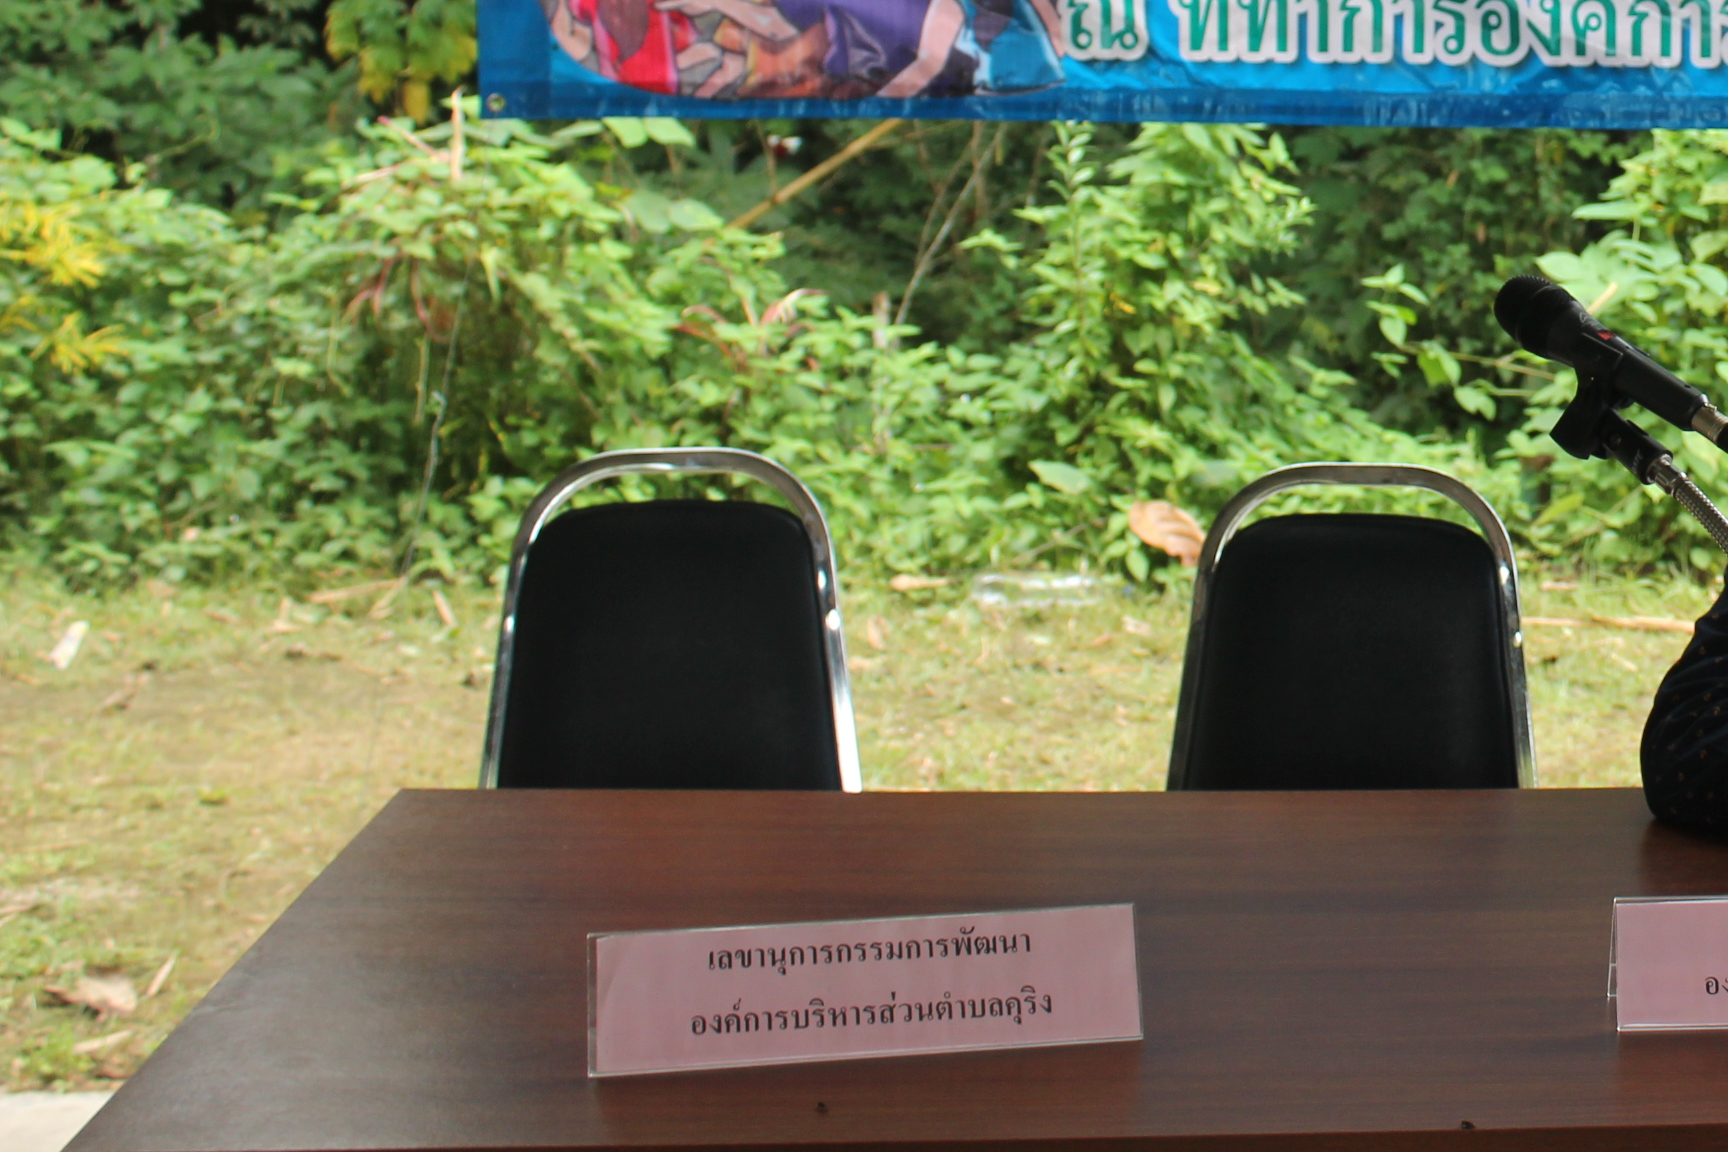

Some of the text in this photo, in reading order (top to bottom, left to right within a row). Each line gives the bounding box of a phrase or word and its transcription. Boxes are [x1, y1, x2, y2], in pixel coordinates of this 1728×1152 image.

[708, 926, 1032, 976] เลขานุการกรรมการพัฒนา
[691, 984, 1053, 1036] องค์การบริหารส่วนตำบลคุริง
